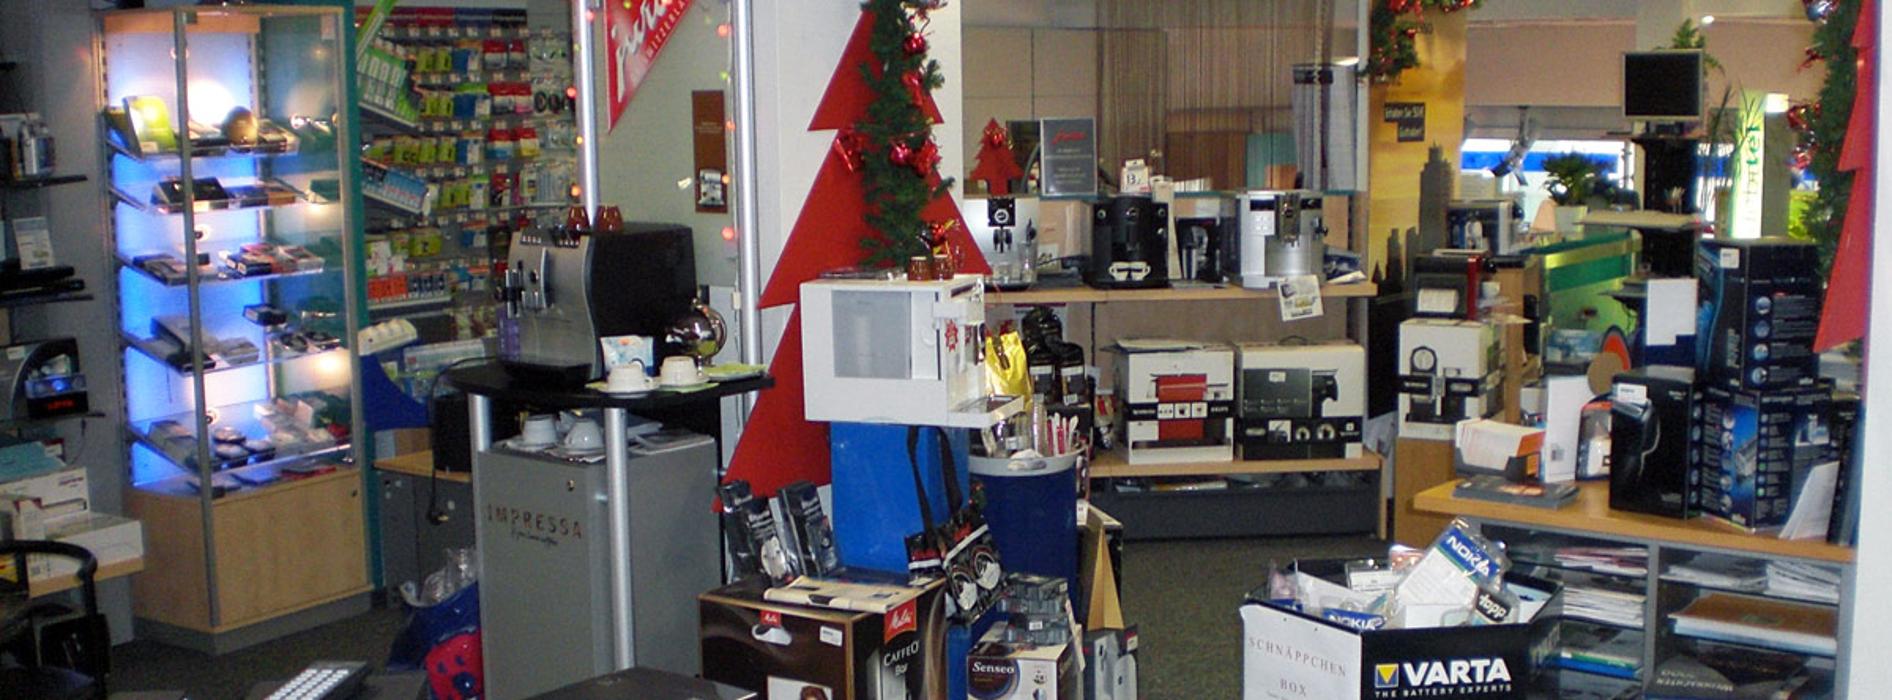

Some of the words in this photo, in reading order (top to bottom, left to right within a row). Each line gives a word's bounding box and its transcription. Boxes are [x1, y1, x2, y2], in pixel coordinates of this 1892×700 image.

[487, 504, 582, 539] IMPRESSA
[1446, 534, 1490, 578] NOKIA
[882, 640, 920, 667] CAFFEO
[1249, 636, 1347, 677] SCHNÄPPCHEN
[971, 661, 1015, 675] Senseo
[1402, 658, 1512, 687] VARTA
[1280, 677, 1307, 697] BOX
[1375, 690, 1397, 698] THE
[1403, 686, 1454, 697] BATTERY
[1459, 683, 1512, 695] EXPERTS
